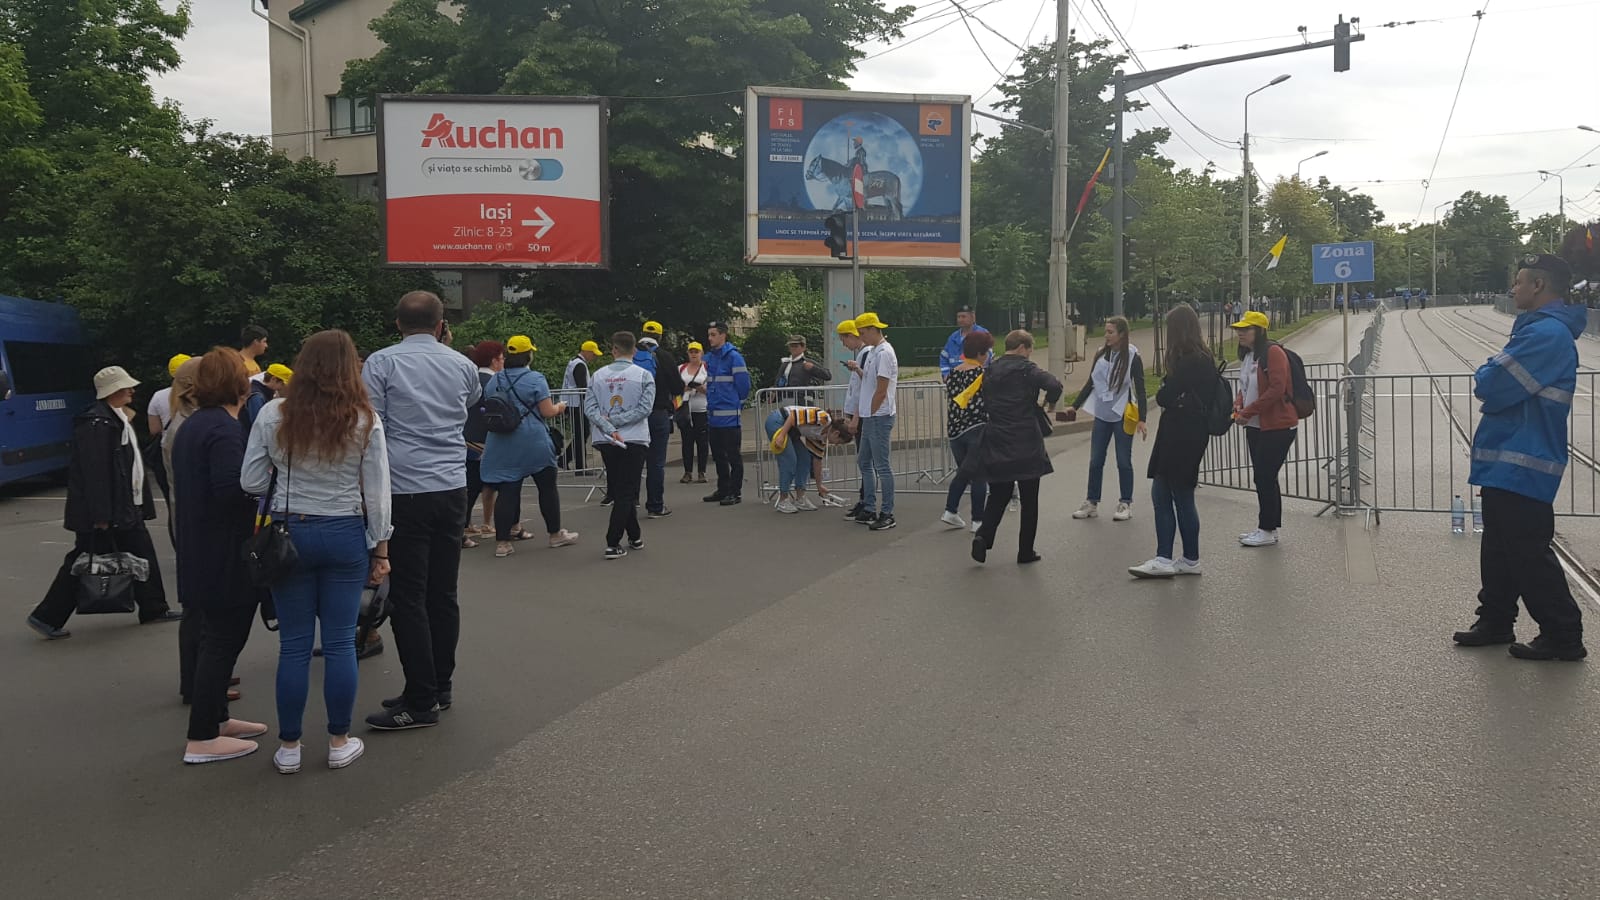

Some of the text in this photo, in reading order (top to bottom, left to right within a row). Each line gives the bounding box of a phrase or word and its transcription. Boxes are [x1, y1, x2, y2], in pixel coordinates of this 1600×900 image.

[777, 107, 784, 116] F
[777, 118, 795, 127] T S
[421, 113, 564, 149] Auchan
[474, 164, 513, 173] schimbă
[480, 202, 512, 225] Iași
[528, 243, 540, 252] 50
[1320, 246, 1366, 258] Zona
[1334, 261, 1352, 278] 6
